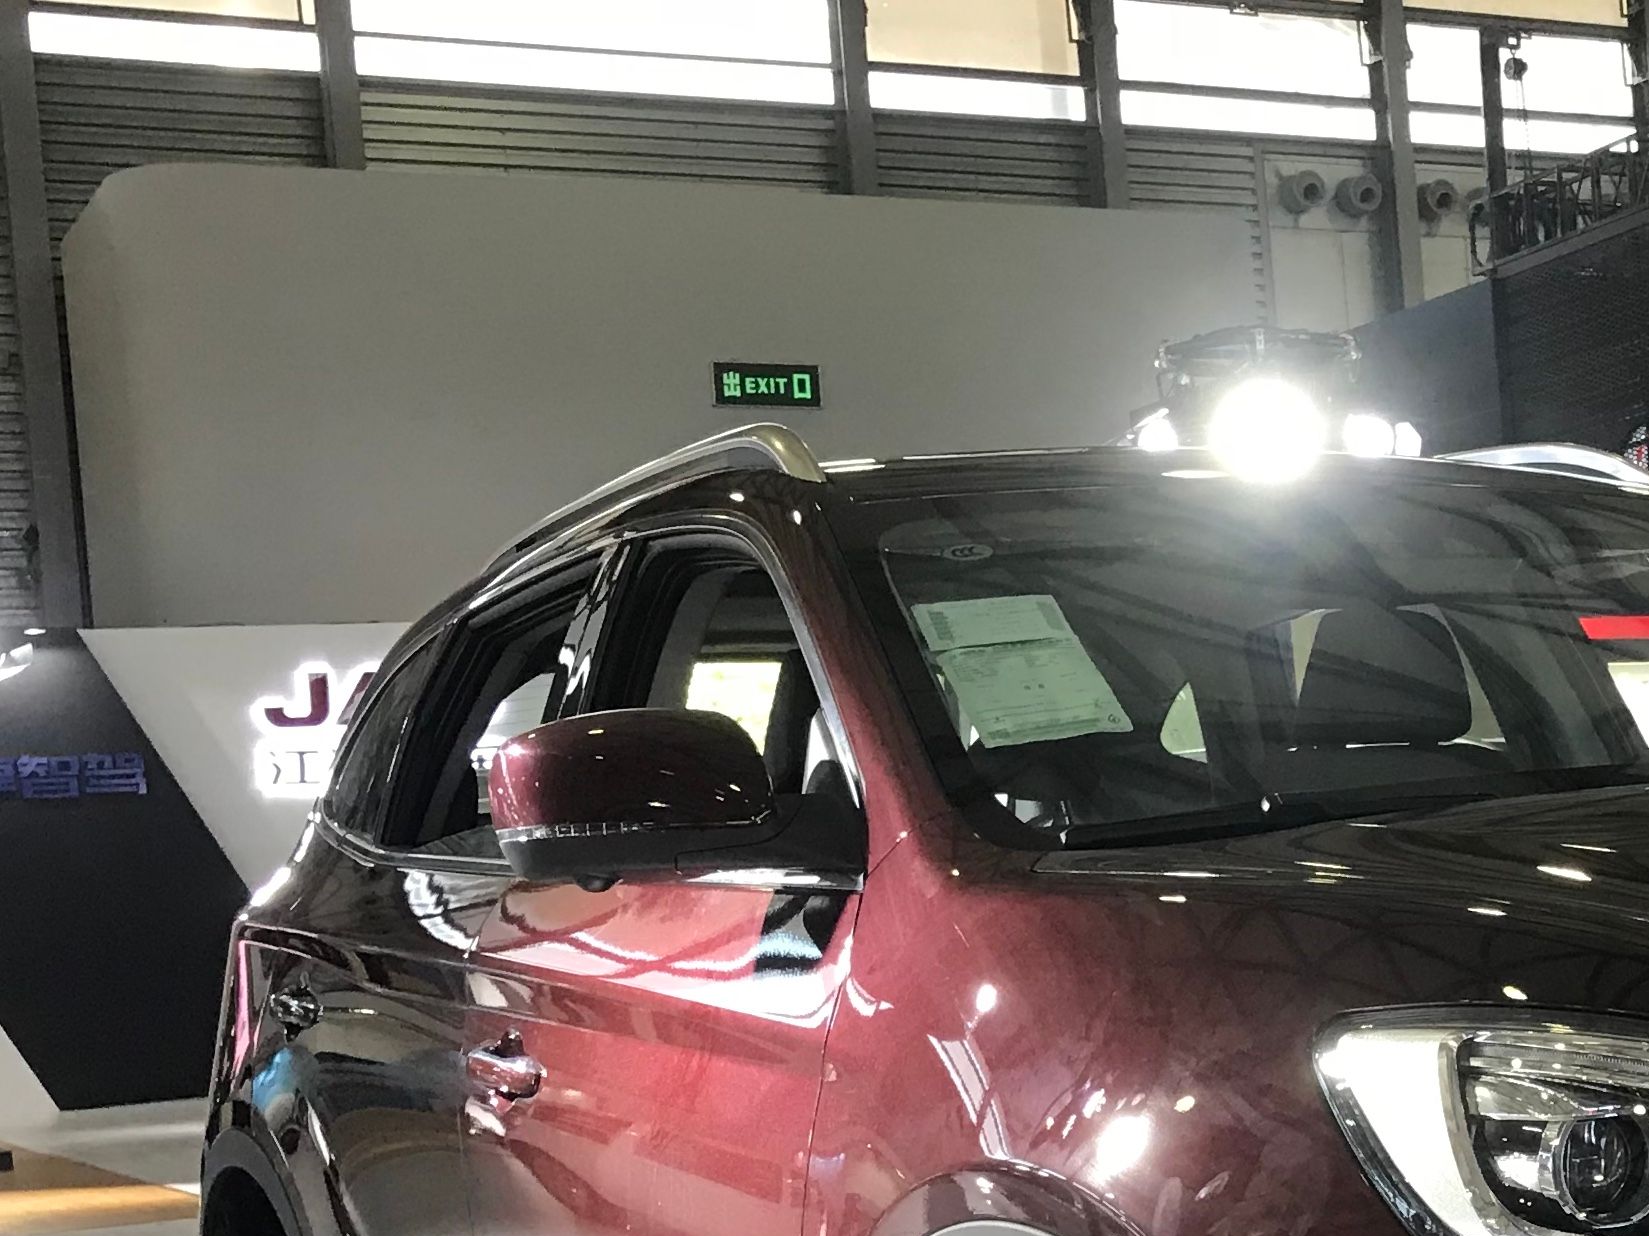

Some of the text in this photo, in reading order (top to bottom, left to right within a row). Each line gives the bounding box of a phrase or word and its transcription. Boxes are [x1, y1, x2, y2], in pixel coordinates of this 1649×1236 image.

[722, 371, 741, 397] 出
[745, 377, 788, 394] EXIT
[264, 750, 336, 785] 江
